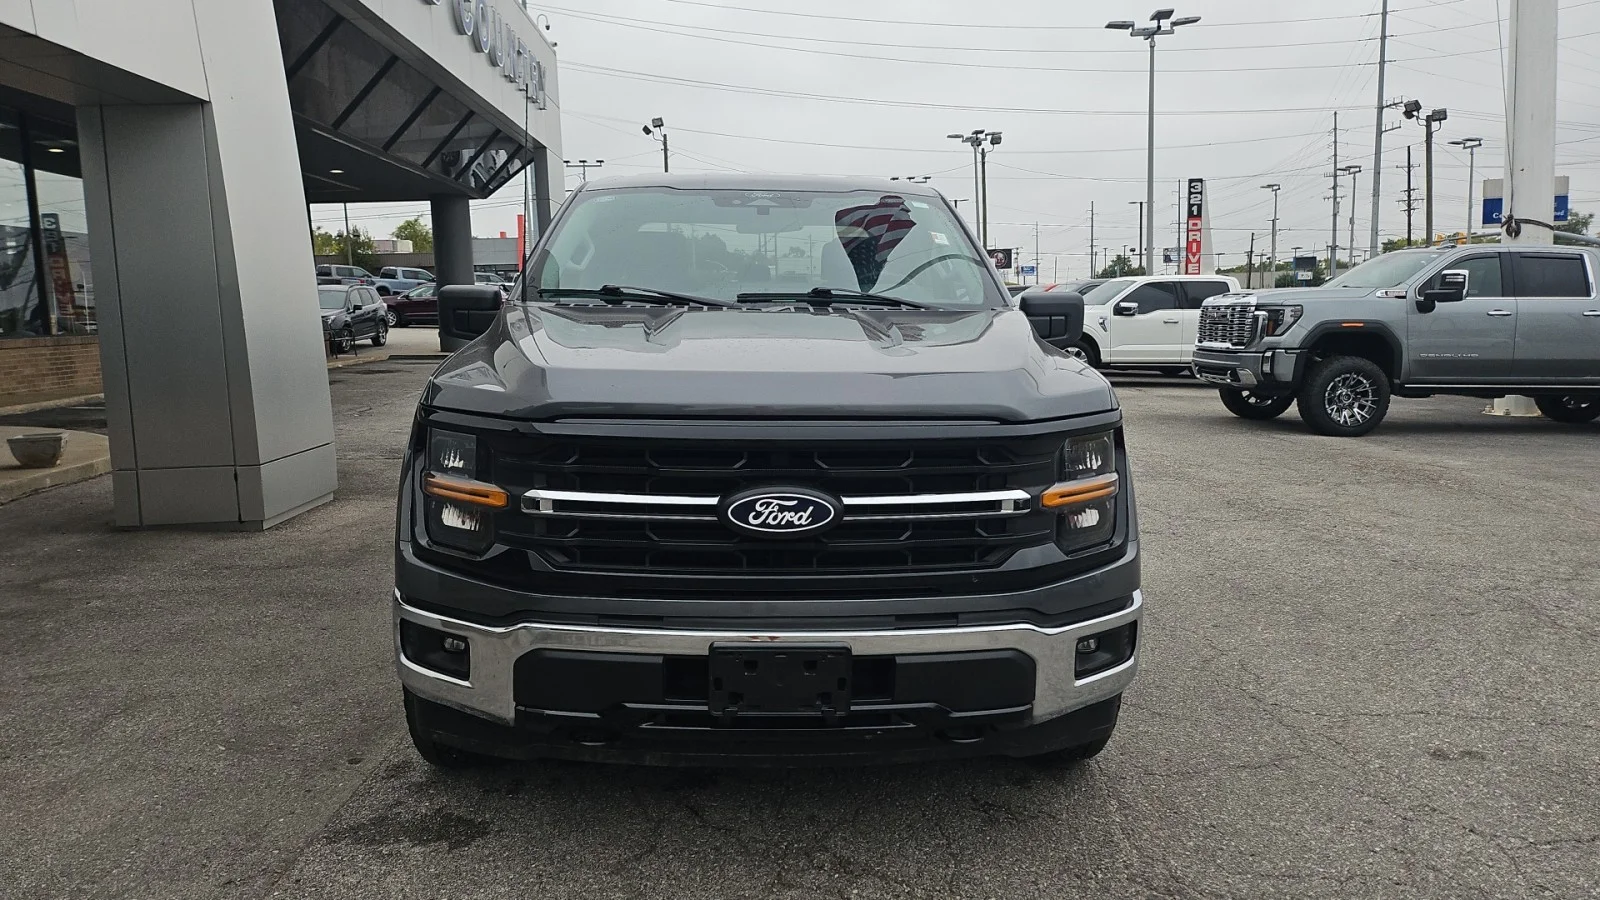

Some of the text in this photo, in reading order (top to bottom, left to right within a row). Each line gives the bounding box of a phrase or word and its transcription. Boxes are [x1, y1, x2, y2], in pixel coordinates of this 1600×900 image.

[1187, 182, 1202, 274] 321 DRIVE
[748, 499, 814, 525] Ford
